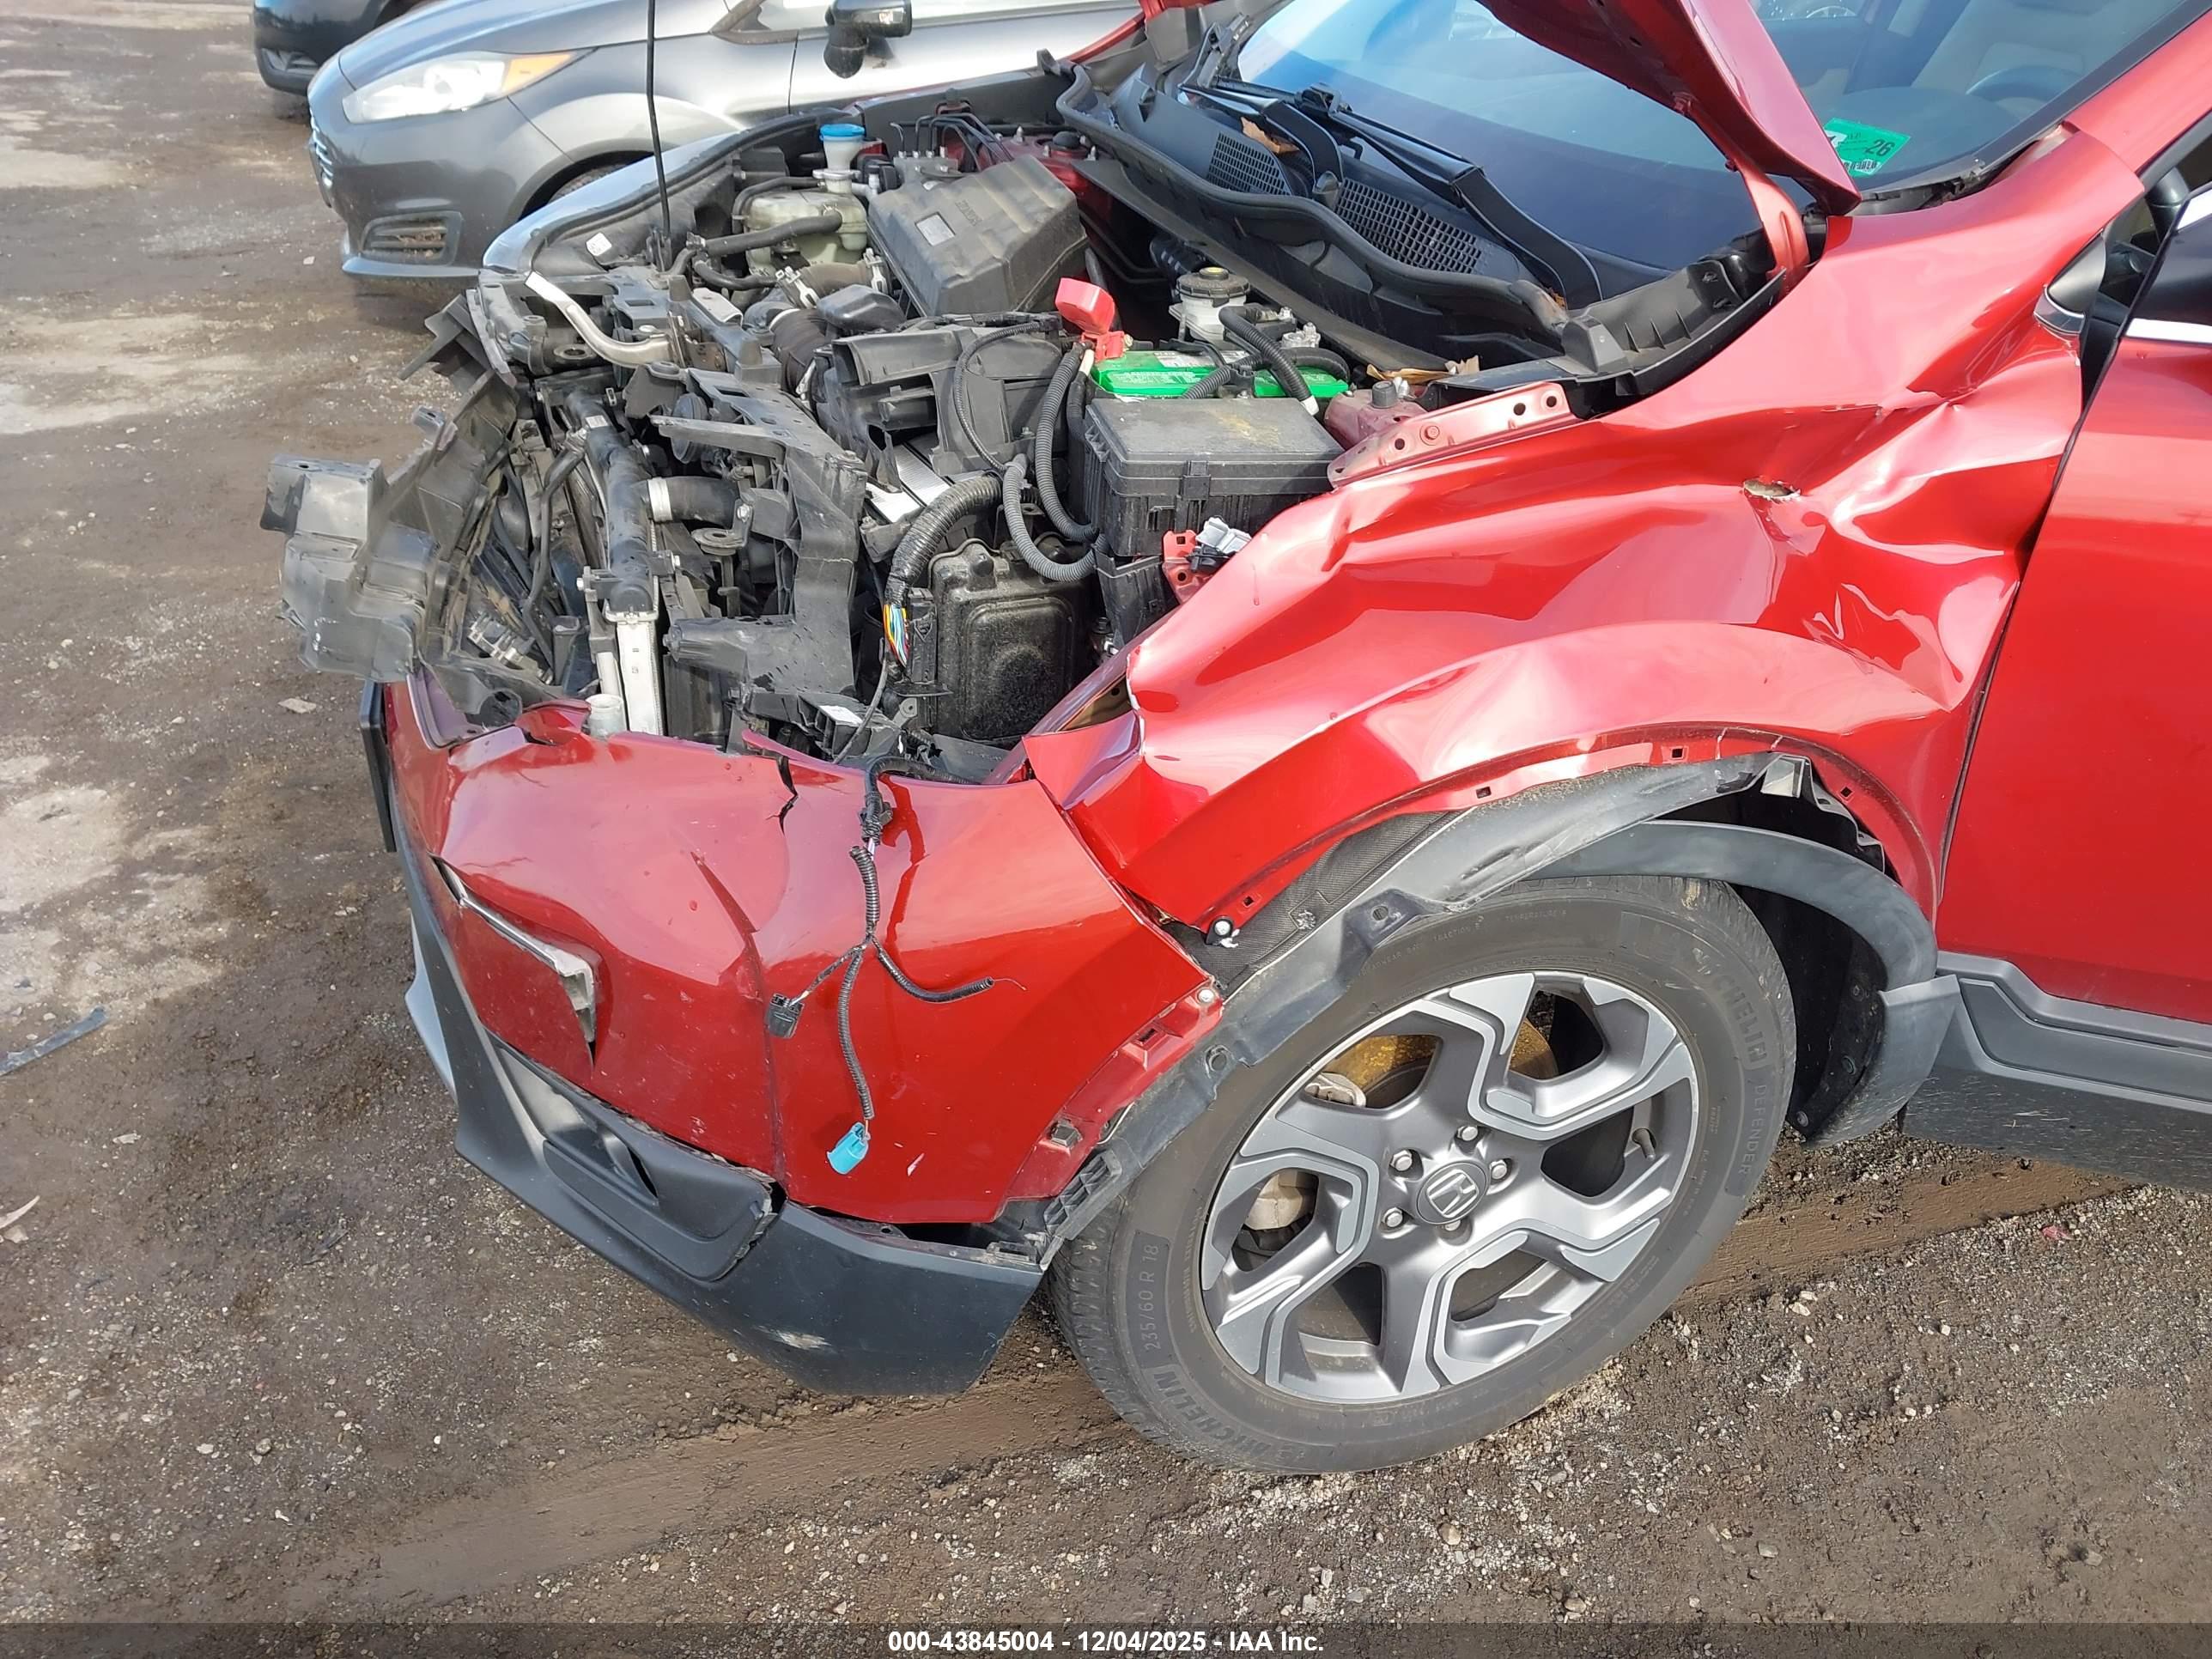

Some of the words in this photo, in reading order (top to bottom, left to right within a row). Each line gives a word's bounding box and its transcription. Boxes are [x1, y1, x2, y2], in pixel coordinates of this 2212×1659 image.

[1864, 138, 1896, 156] 26
[1738, 1085, 1766, 1175] DEFENDER
[1142, 1243, 1159, 1263] 18
[1139, 1270, 1155, 1283] R
[1138, 1291, 1161, 1351] 235/60
